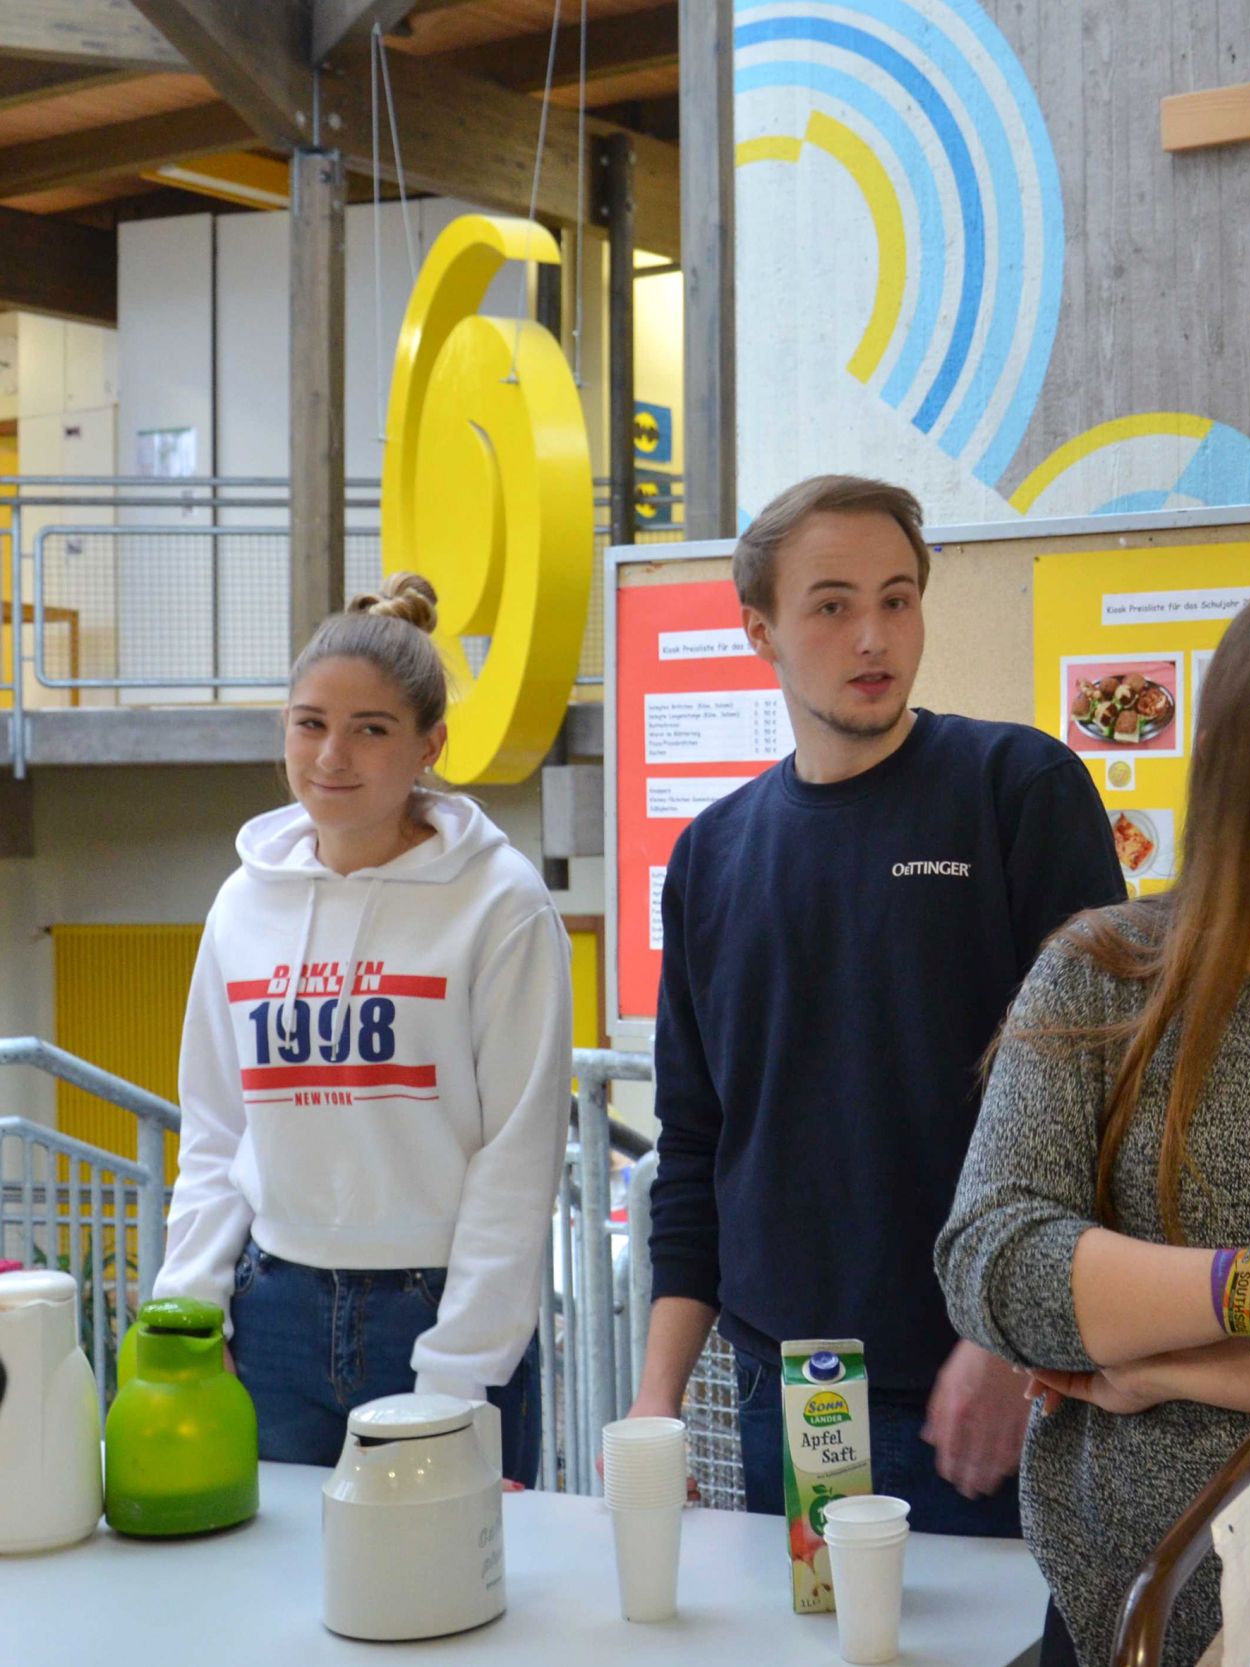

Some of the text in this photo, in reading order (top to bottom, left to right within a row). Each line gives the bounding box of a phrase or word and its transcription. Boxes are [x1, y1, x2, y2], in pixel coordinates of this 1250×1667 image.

[1129, 604, 1165, 612] Preisliste
[1168, 602, 1180, 611] für
[1184, 602, 1197, 610] das
[1201, 599, 1239, 610] Schuljahr
[249, 997, 395, 1065] 1998
[295, 1091, 352, 1106] NEW YORK
[801, 1430, 843, 1450] Apfel
[822, 1446, 856, 1464] Saft
